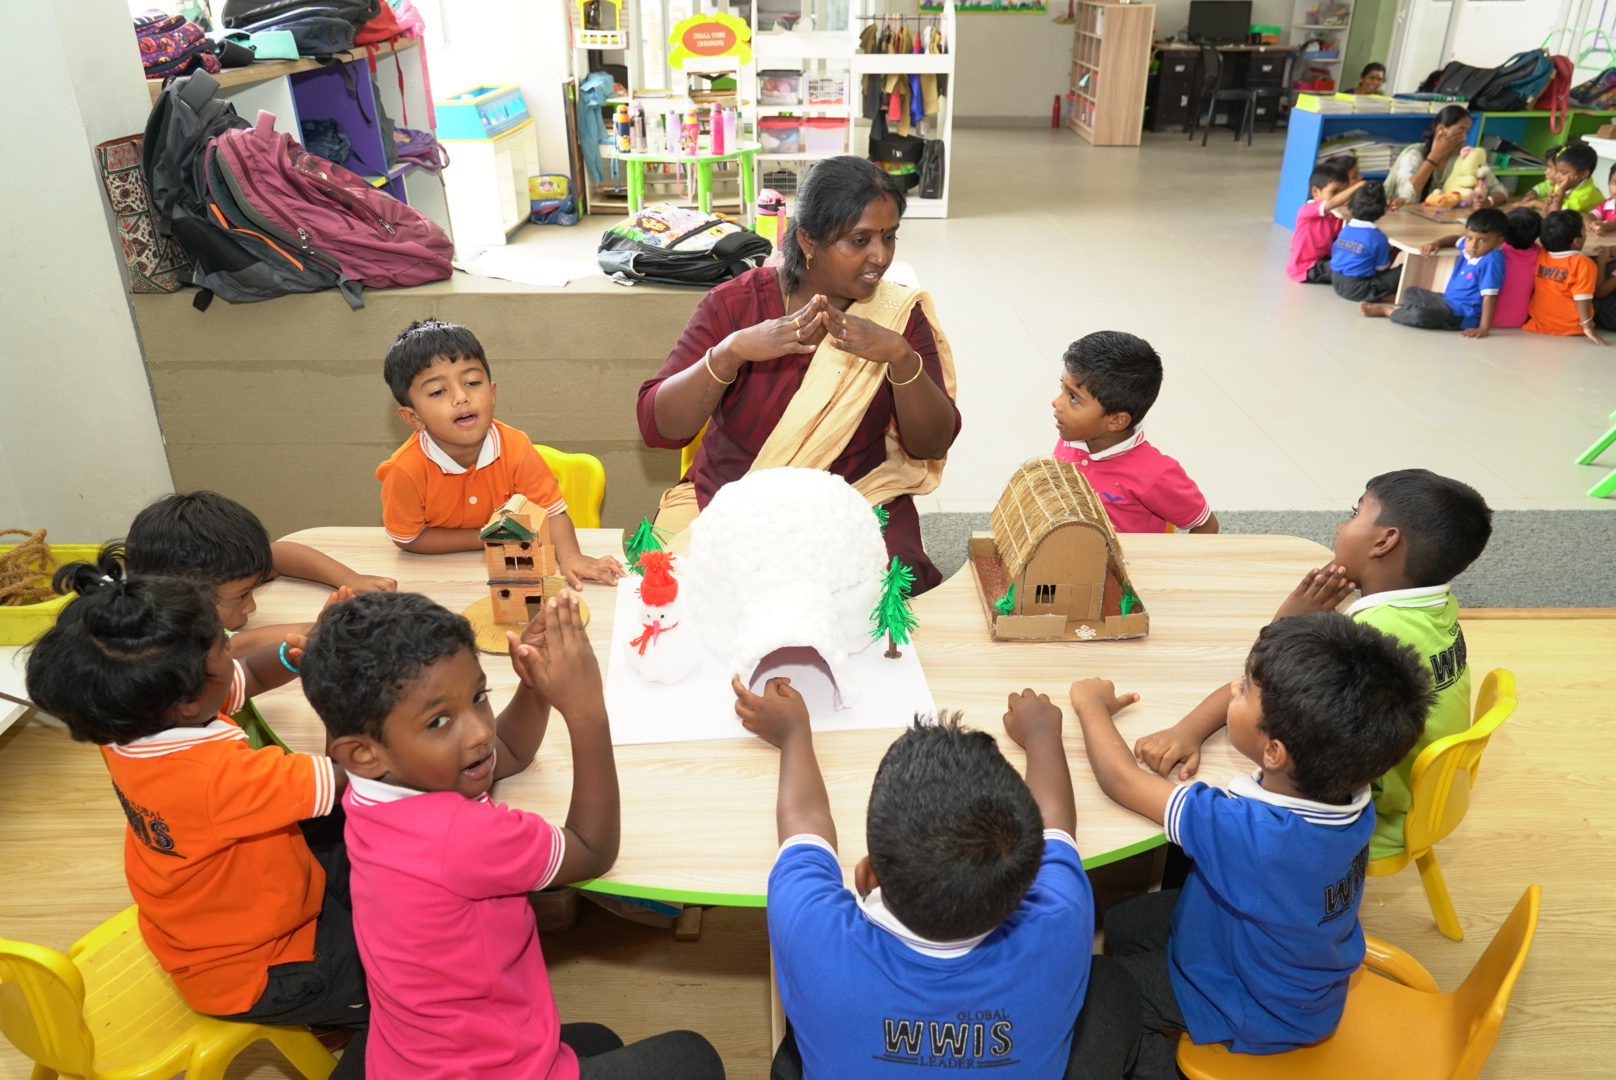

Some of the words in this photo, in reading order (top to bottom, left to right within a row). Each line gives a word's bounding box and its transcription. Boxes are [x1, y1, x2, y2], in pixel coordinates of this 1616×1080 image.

[956, 1008, 1010, 1022] GLOBAL
[882, 1018, 1013, 1058] WWIS
[919, 1057, 976, 1069] LEADER
